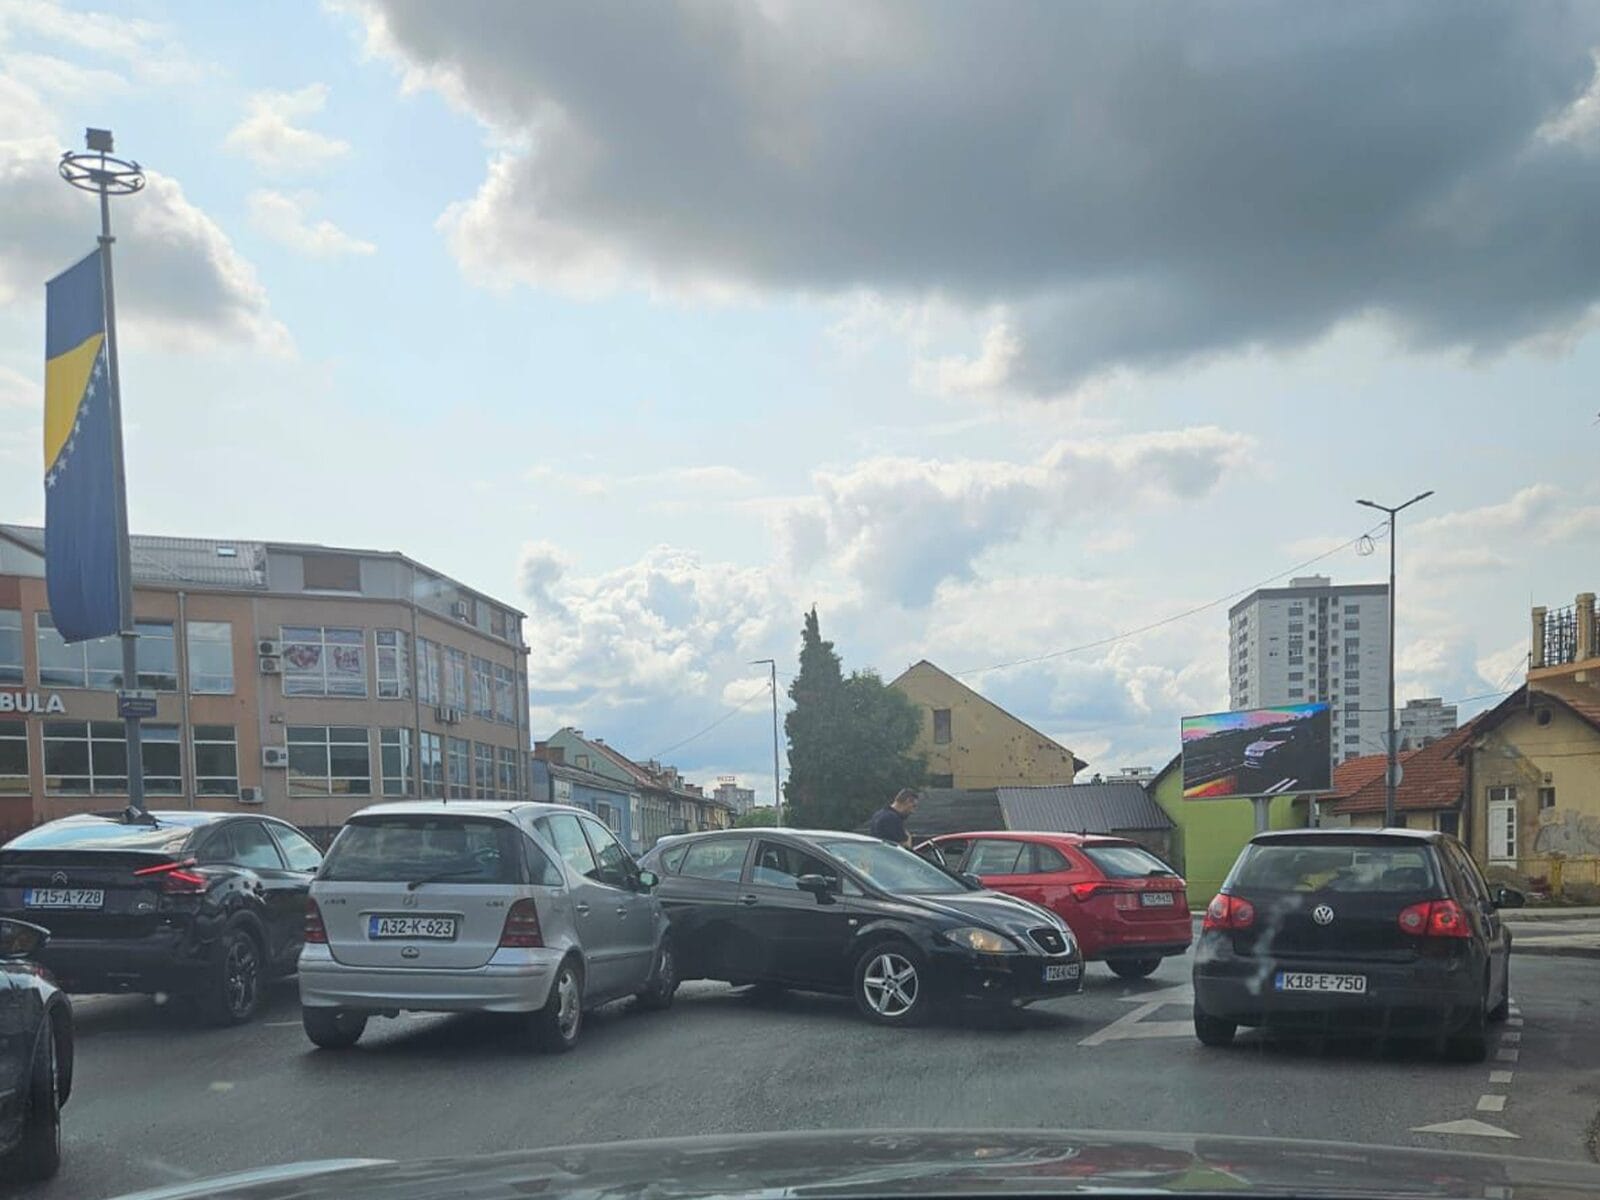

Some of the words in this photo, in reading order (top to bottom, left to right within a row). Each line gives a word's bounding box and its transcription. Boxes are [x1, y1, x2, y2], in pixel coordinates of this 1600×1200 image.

[0, 692, 65, 713] BULA
[34, 890, 102, 904] T15-A-728
[380, 919, 452, 936] A32-K-623
[1285, 974, 1364, 992] K18-E-750
